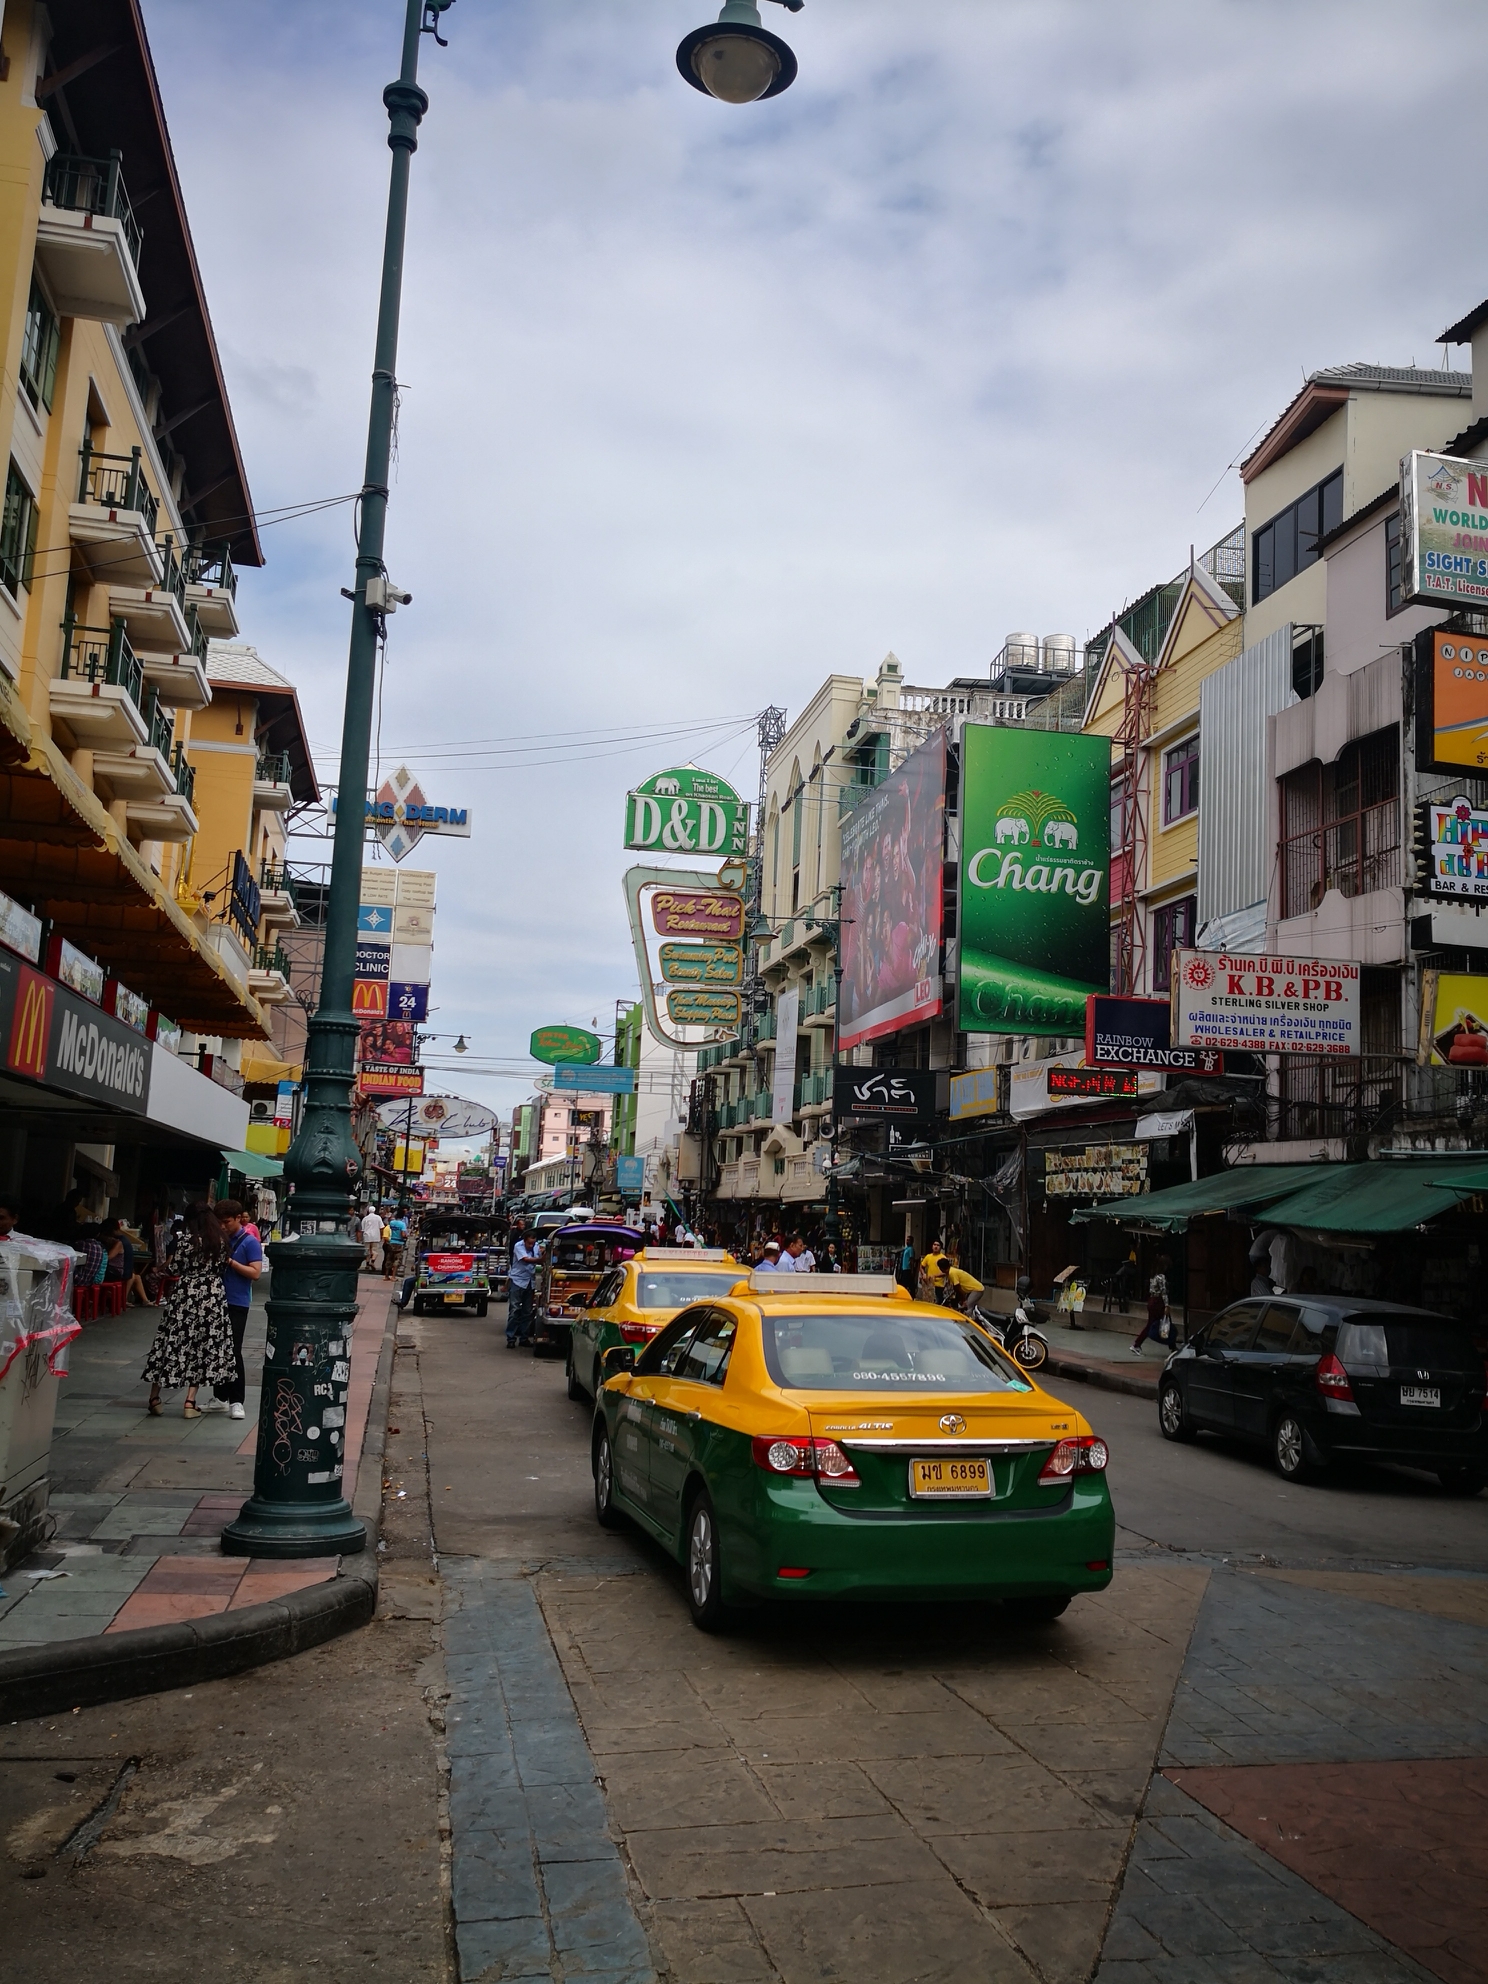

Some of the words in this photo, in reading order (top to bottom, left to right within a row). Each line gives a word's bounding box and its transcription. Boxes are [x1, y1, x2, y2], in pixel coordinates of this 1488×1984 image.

[1426, 552, 1472, 574] SIGHT
[1477, 560, 1488, 576] S
[1426, 574, 1454, 591] T.A.T.
[693, 783, 704, 792] The
[705, 783, 718, 794] best
[406, 803, 467, 825] DERM
[629, 797, 727, 852] D&D
[732, 805, 747, 851] INN
[968, 848, 1104, 906] Chang
[1435, 881, 1456, 892] BAR
[1461, 882, 1470, 893] &
[656, 895, 740, 918] Pick-Thai
[666, 915, 732, 932] Restaurant
[663, 946, 713, 966] Swimming
[669, 962, 703, 980] Beauty
[704, 964, 735, 980] Salon
[914, 979, 931, 1003] LEO
[398, 996, 417, 1008] 24
[1211, 997, 1262, 1008] STERLING
[1265, 1000, 1300, 1011] SILVER
[1302, 1002, 1330, 1012] SHOP
[1194, 1024, 1266, 1038] WHOLESALER
[1268, 1028, 1276, 1038] &
[1318, 1019, 1352, 1033] ทุกชนิด
[1096, 1033, 1153, 1047] RAINBOW
[56, 1009, 145, 1098] McDonald's
[1095, 1045, 1196, 1067] EXCHANGE
[365, 1065, 388, 1073] TASTE
[400, 1067, 420, 1075] INDIA
[362, 1073, 396, 1086] INDIAN
[396, 1076, 421, 1088] FOOD
[440, 1113, 490, 1130] Club
[444, 1179, 457, 1188] 24
[1418, 1388, 1439, 1399] 7514
[857, 1422, 894, 1431] ALTIS
[950, 1464, 986, 1480] 6899
